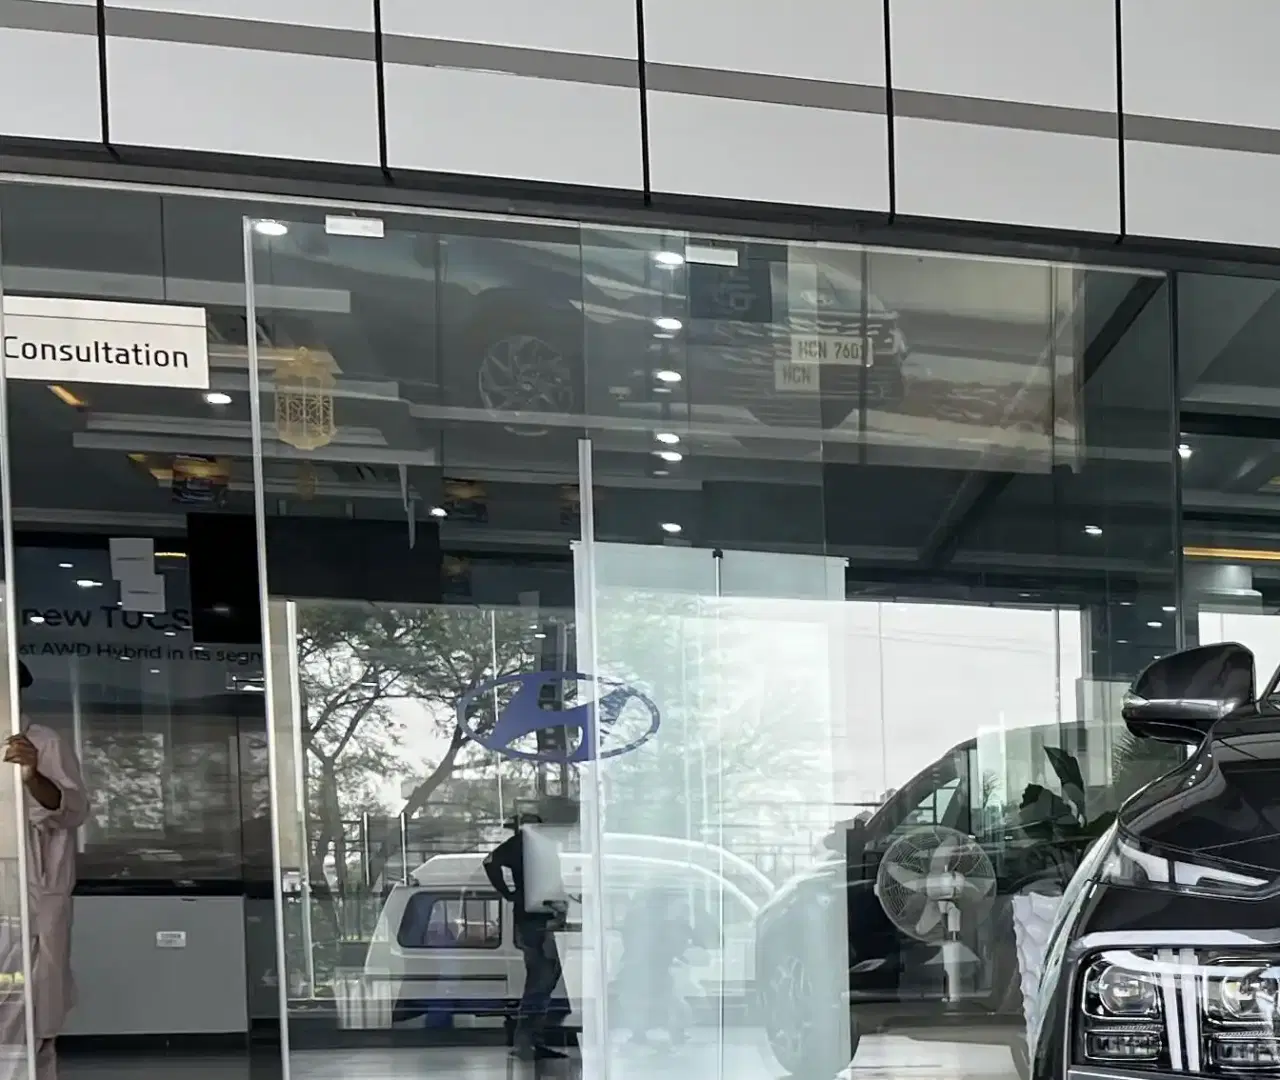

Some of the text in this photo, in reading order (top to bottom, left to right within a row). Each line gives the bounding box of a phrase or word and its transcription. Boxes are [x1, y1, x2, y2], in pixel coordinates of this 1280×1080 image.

[4, 336, 189, 368] Consultation
[22, 607, 91, 628] new
[41, 642, 90, 657] AWD
[97, 644, 162, 662] Hybrid
[167, 645, 183, 660] in
